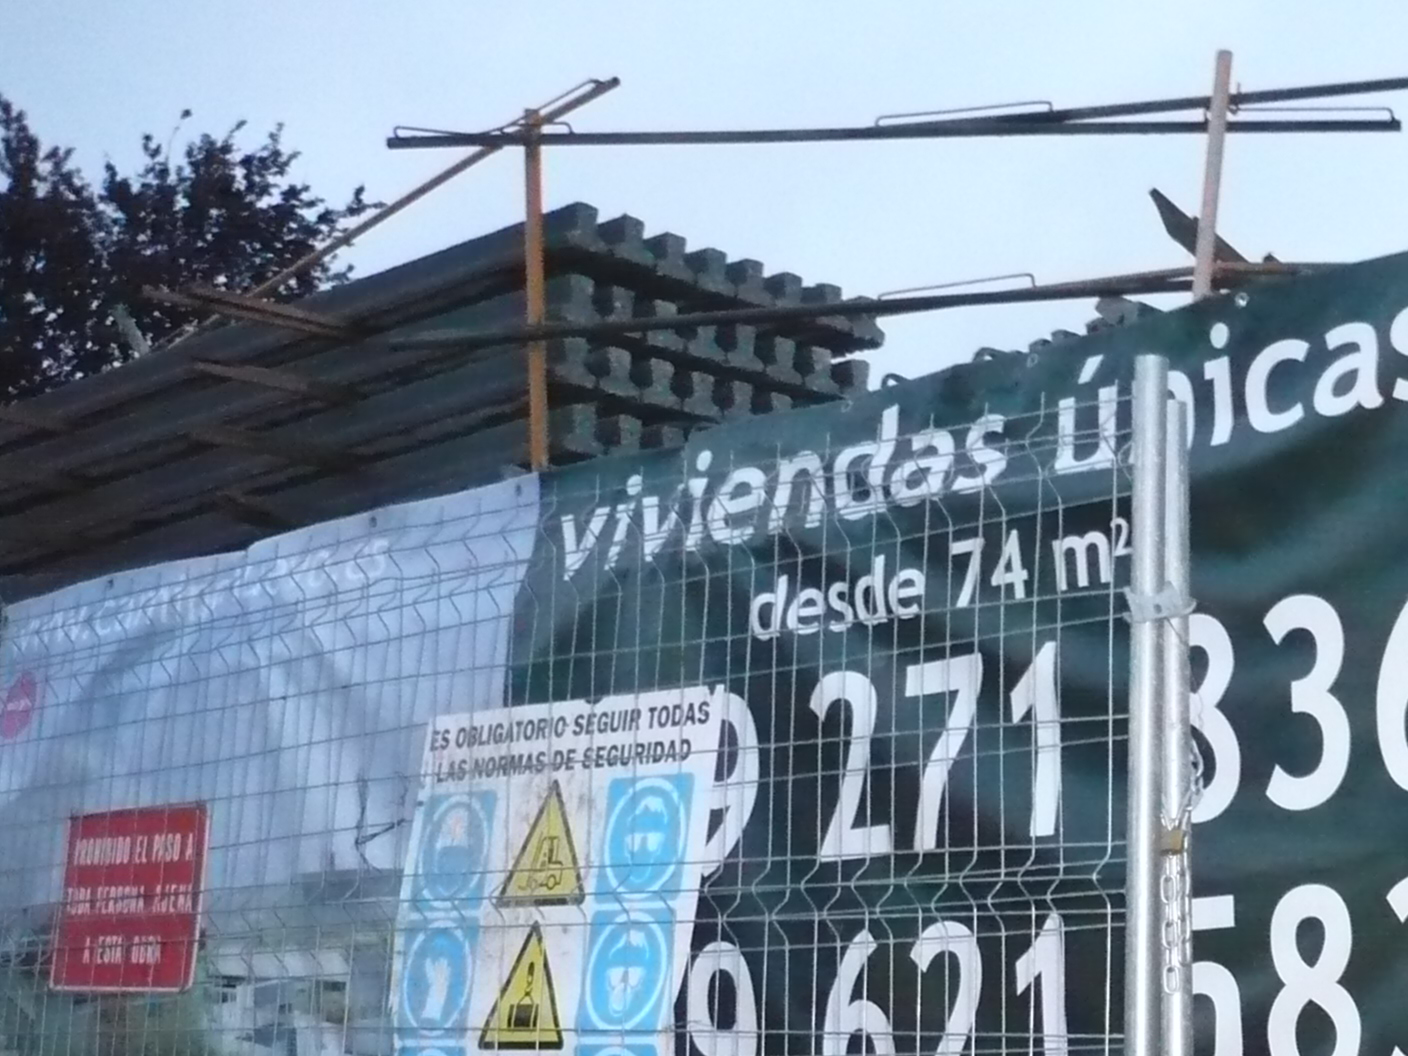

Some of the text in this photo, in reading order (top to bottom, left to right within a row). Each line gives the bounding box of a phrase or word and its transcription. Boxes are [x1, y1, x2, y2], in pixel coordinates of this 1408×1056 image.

[560, 403, 1008, 581] viviendas
[750, 554, 926, 641] desde
[950, 529, 1028, 608] 74
[431, 701, 711, 751] ES OBLIGATORIO SEGUIR TODAS
[437, 738, 692, 783] LAS NORMAS DE SEGURIDAD
[809, 640, 1056, 863] 271
[134, 834, 149, 864] EL
[151, 832, 182, 864] PASO
[185, 832, 194, 861] A
